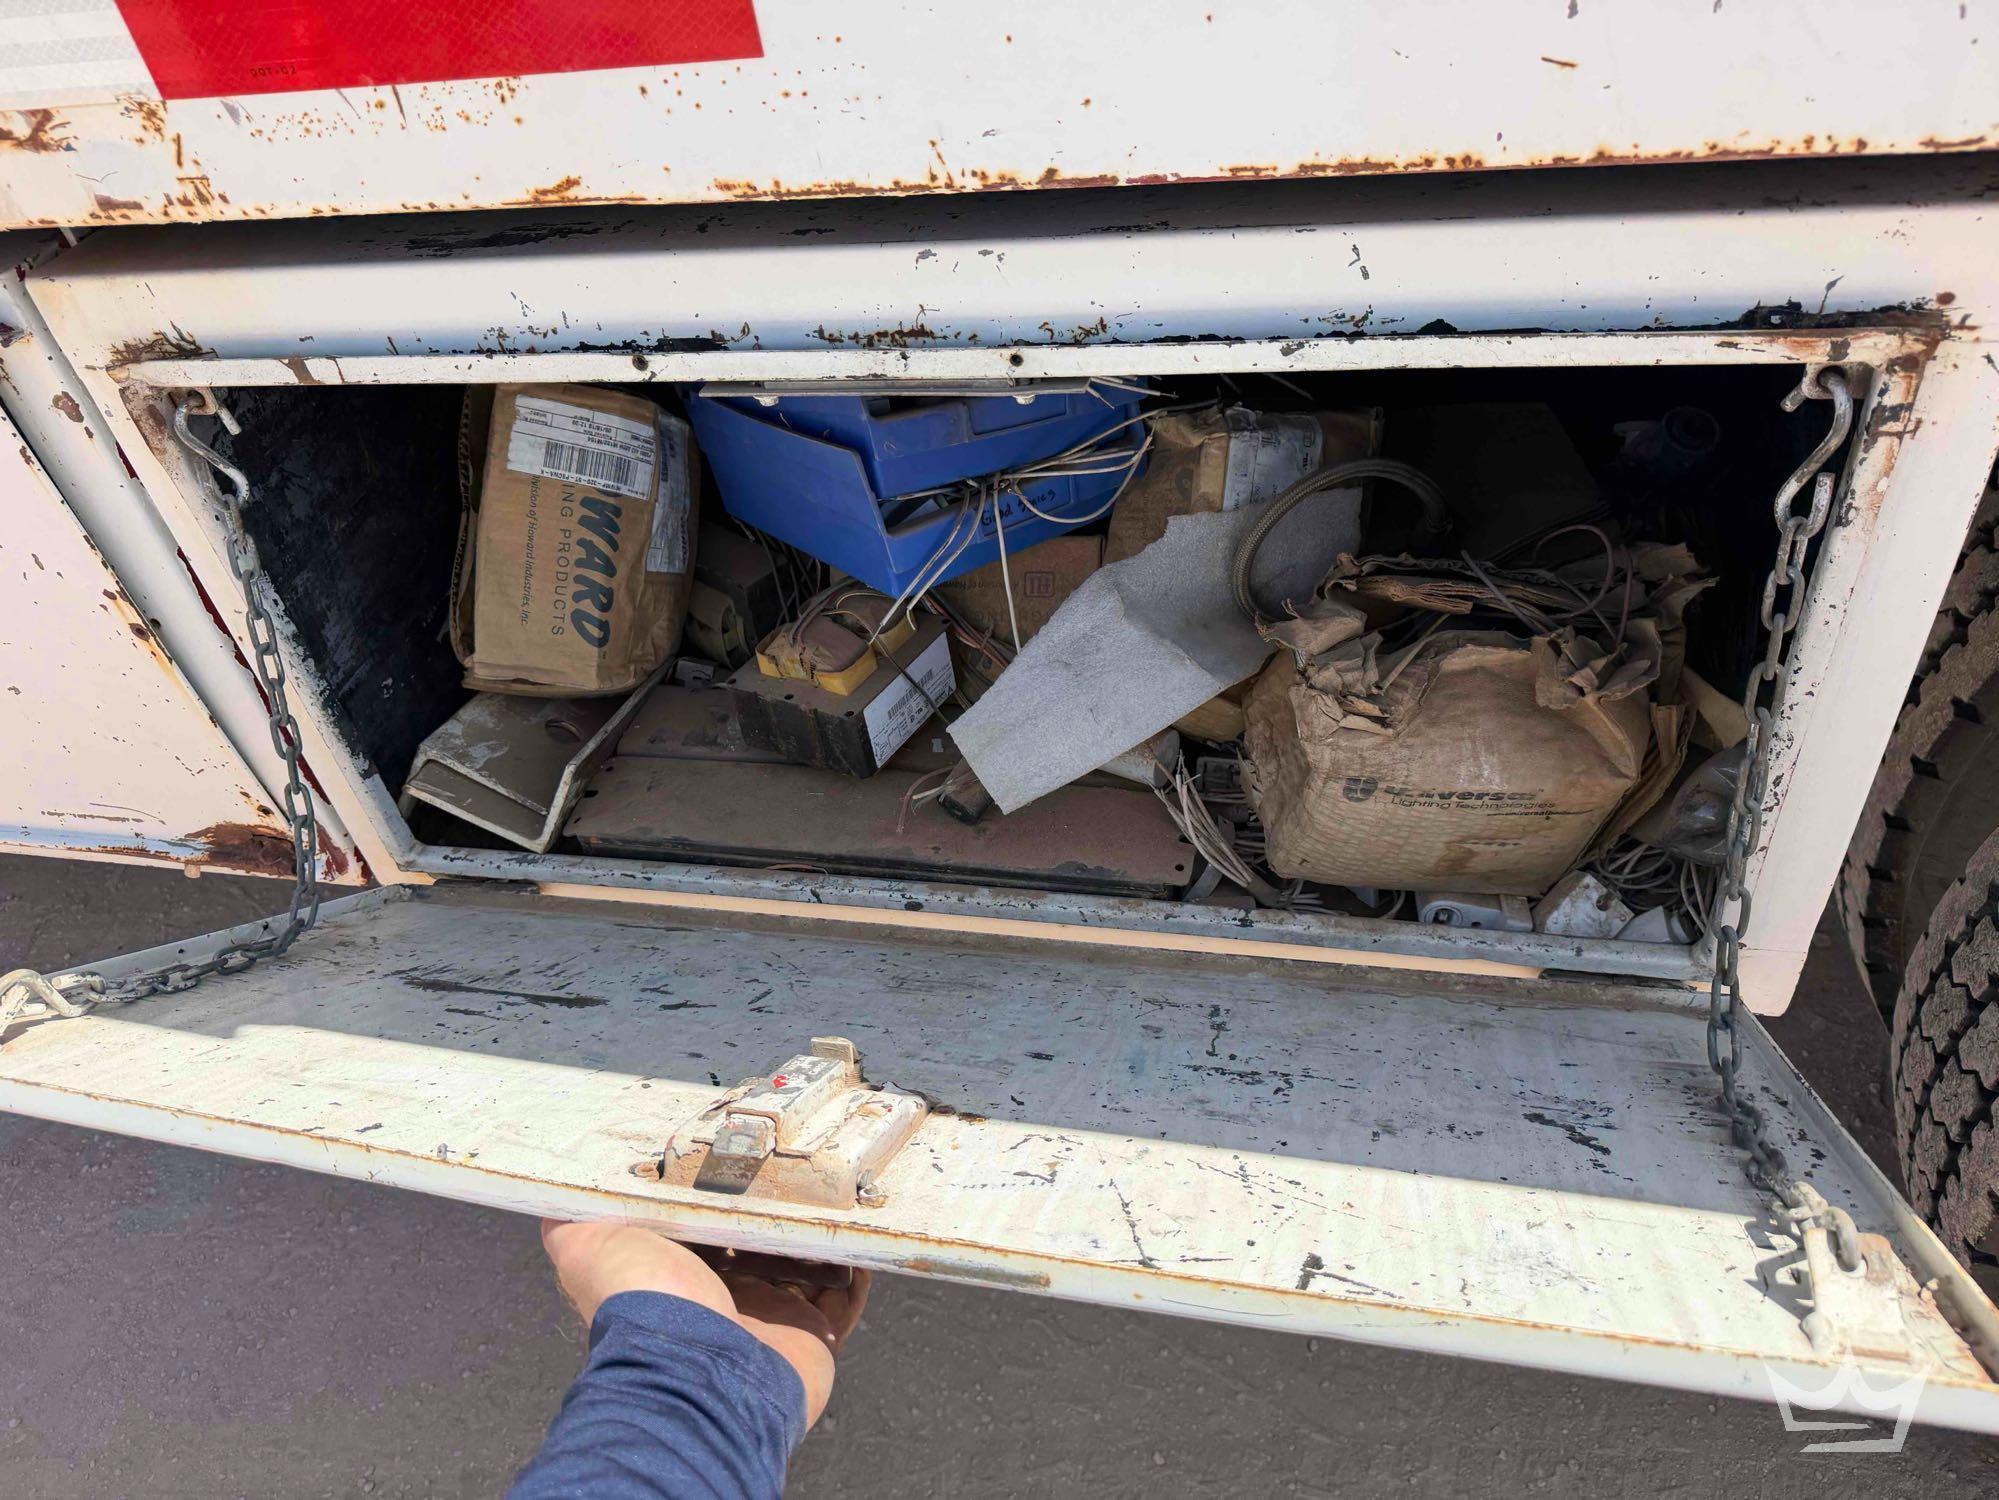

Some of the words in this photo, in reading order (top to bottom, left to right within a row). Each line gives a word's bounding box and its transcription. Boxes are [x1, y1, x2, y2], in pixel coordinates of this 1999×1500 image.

[527, 509, 539, 521] of
[559, 484, 576, 518] ING
[980, 503, 1014, 526] God
[526, 521, 538, 559] Howard
[551, 528, 572, 636] PRODUCTS
[569, 488, 623, 648] WARD
[1391, 797, 1452, 810] Lighting
[1455, 800, 1556, 810] Technologies
